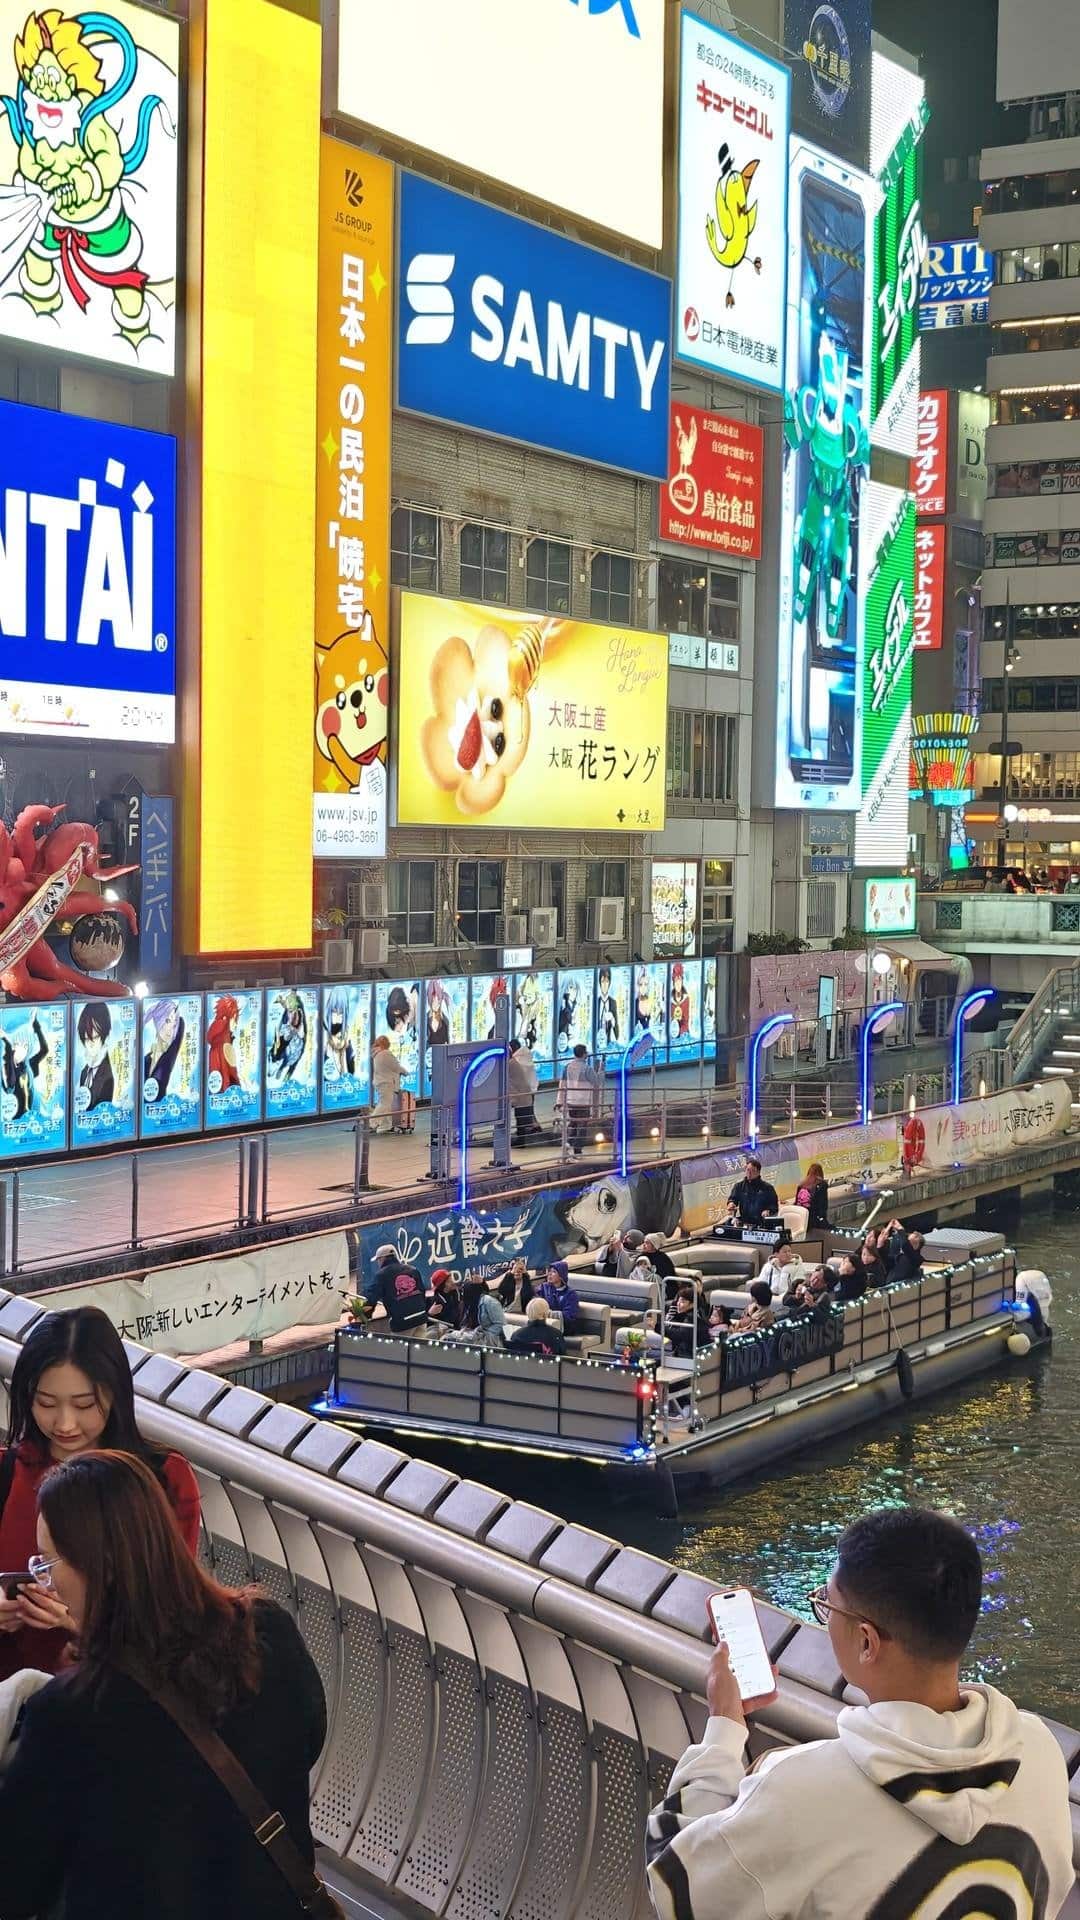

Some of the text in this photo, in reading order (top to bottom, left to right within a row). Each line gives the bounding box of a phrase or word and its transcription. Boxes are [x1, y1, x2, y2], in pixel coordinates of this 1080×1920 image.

[696, 80, 774, 140] キュービクル
[345, 214, 373, 233] GROUP
[471, 273, 665, 412] SAMTY
[702, 320, 778, 368] 日本電機産業
[915, 395, 940, 496] カラオケ
[915, 530, 936, 647] ネットカフェ
[548, 700, 606, 731] 大阪土産
[548, 739, 661, 784] 大阪 花ラング
[316, 829, 379, 844] 06-4963-3661
[317, 806, 378, 825] www.jsv.jp
